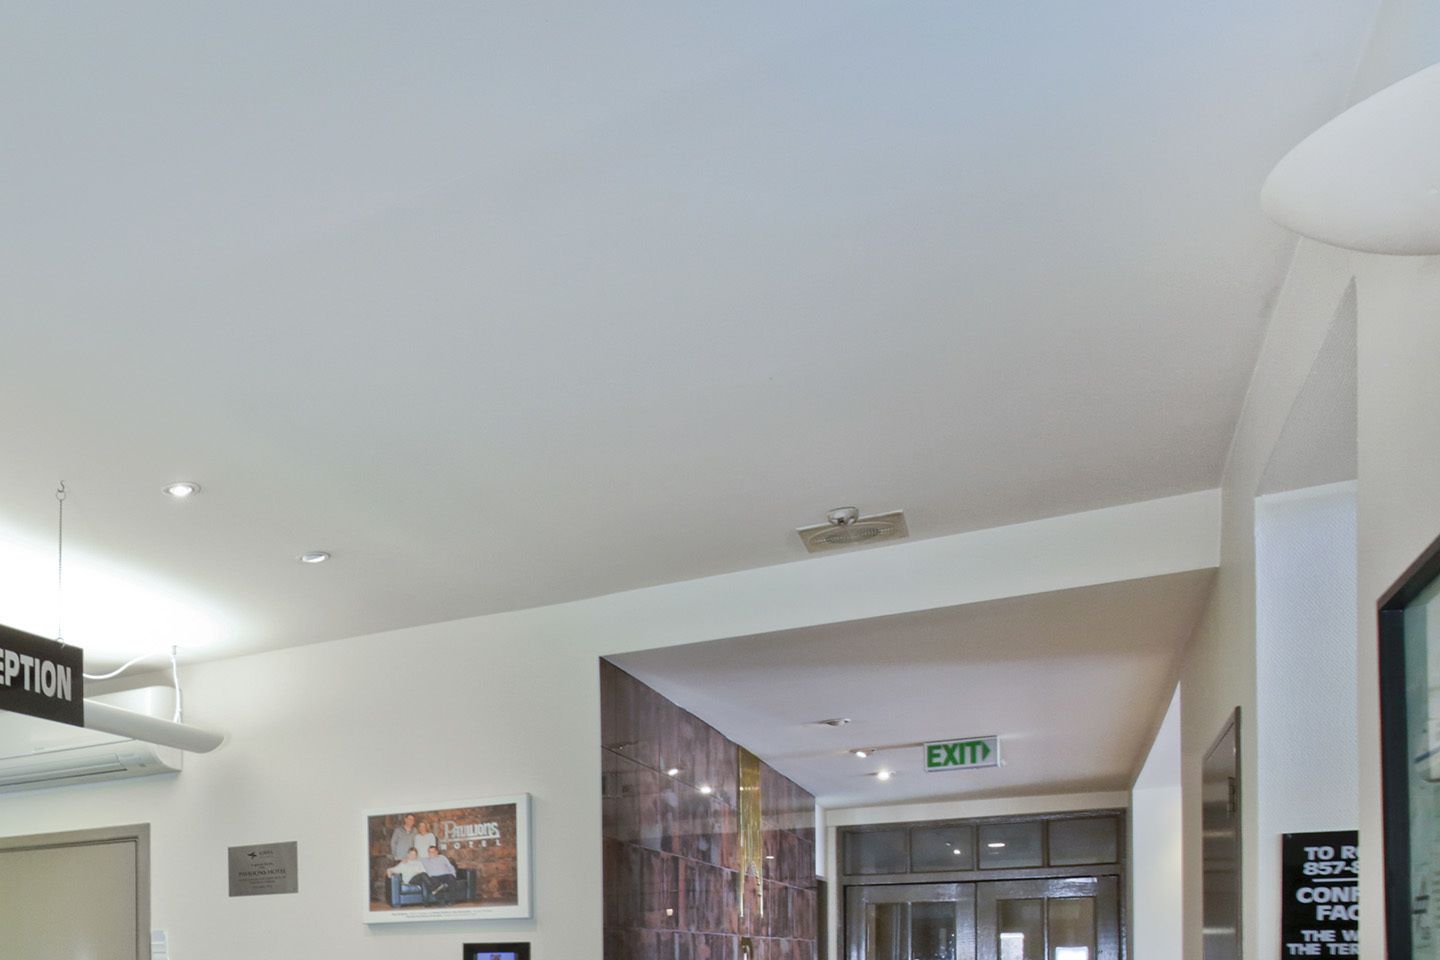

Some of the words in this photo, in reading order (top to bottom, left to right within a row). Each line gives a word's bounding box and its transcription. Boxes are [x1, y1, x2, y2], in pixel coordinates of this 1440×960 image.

[927, 740, 982, 768] EXIT
[1303, 846, 1335, 860] TO
[1301, 930, 1336, 942] THE
[1286, 943, 1321, 955] THE
